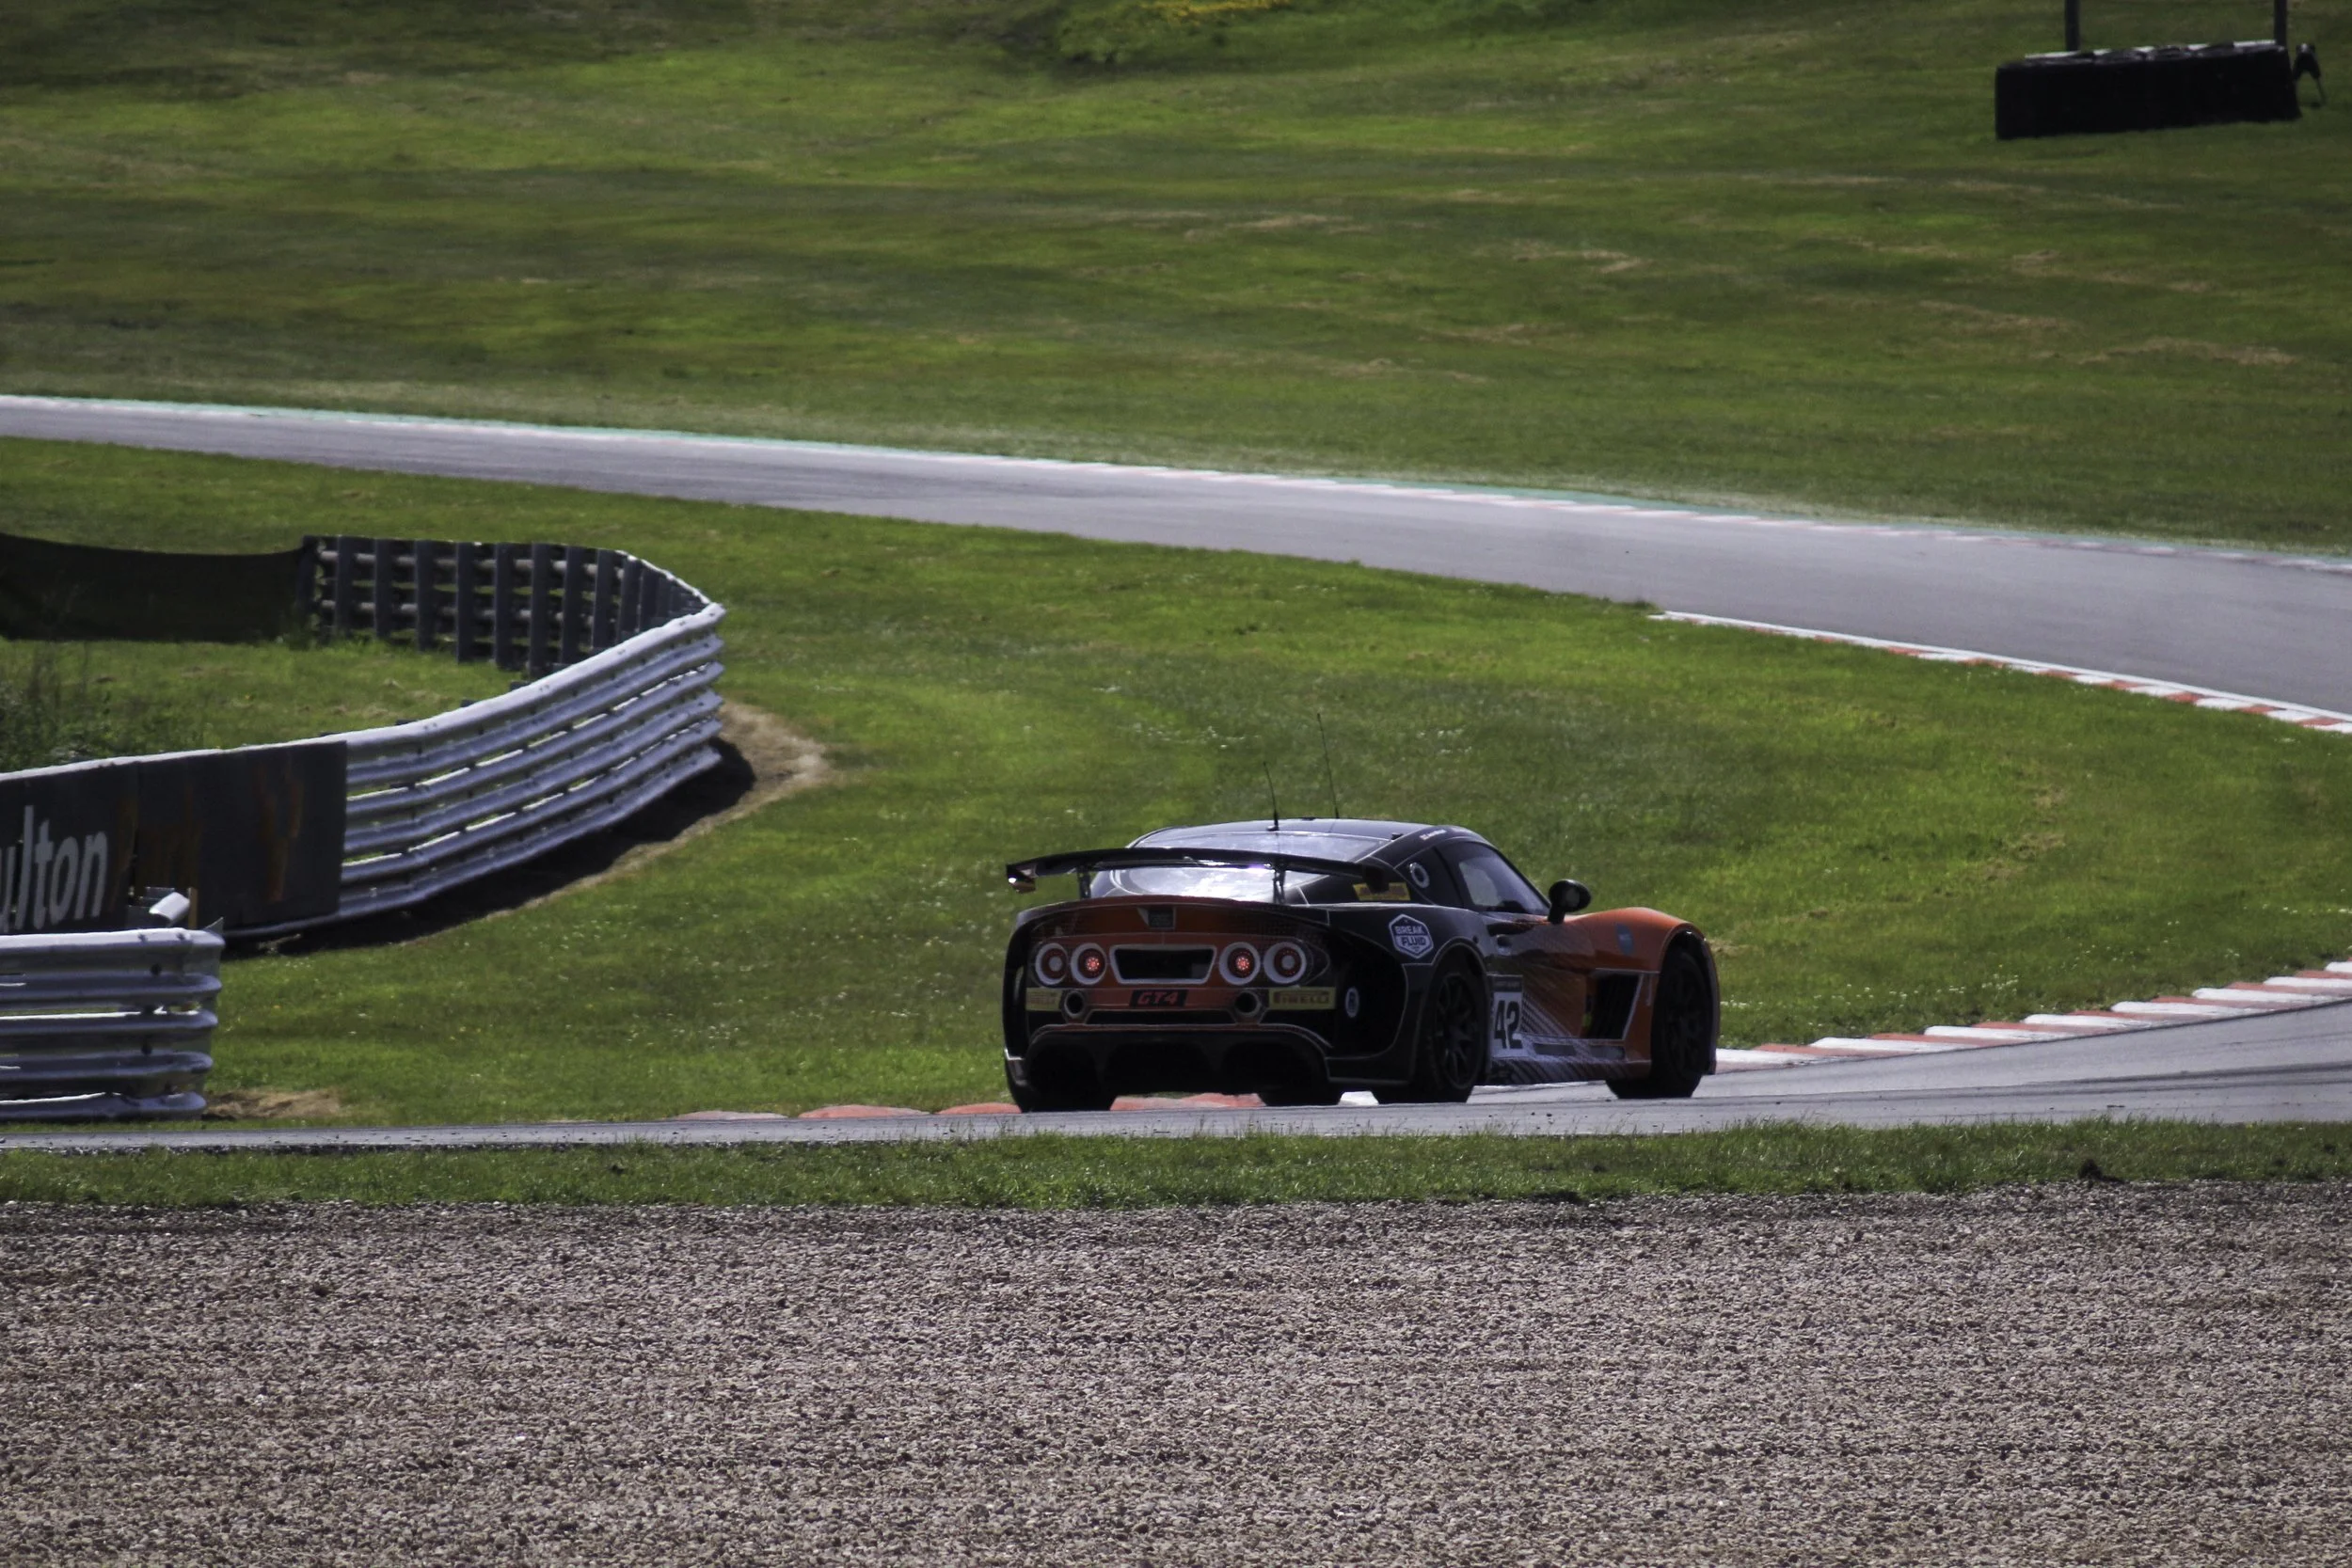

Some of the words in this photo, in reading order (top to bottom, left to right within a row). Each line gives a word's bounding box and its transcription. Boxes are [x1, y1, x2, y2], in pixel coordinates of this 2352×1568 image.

[1394, 926, 1424, 935] BREAK
[1401, 936, 1426, 946] FLUID
[1136, 991, 1177, 1005] GT4
[1495, 1000, 1523, 1049] 42
